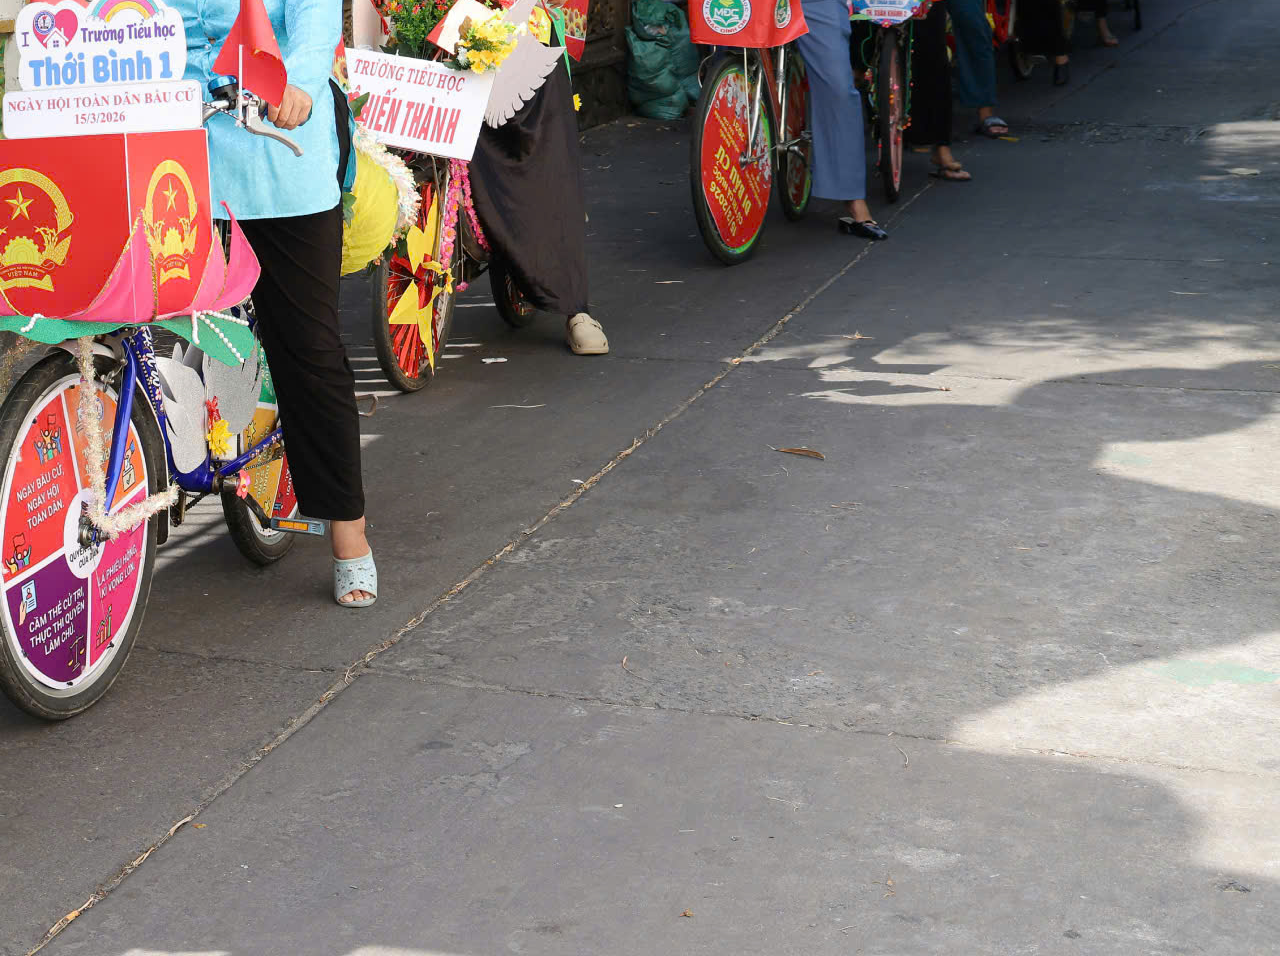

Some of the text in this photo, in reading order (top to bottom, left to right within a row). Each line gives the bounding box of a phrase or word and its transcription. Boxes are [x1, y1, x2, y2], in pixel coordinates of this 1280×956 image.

[21, 32, 29, 47] I
[81, 19, 176, 44] Trường Tiểu học
[29, 49, 173, 86] Thới Bình 1
[354, 58, 465, 95] TRƯỜNG TIỂU HỌC
[8, 87, 196, 112] NGÀY HỘI TOÀN DÂN BẦU CỬ
[74, 111, 126, 125] 15/3/2026
[400, 97, 461, 144] THÀNH
[16, 481, 35, 502] NGÀY
[26, 483, 60, 513] NGÀY HỘI
[27, 509, 47, 529] TOÀN
[30, 627, 51, 648] THỰC
[53, 617, 64, 633] THI
[44, 636, 60, 655] LÀM
